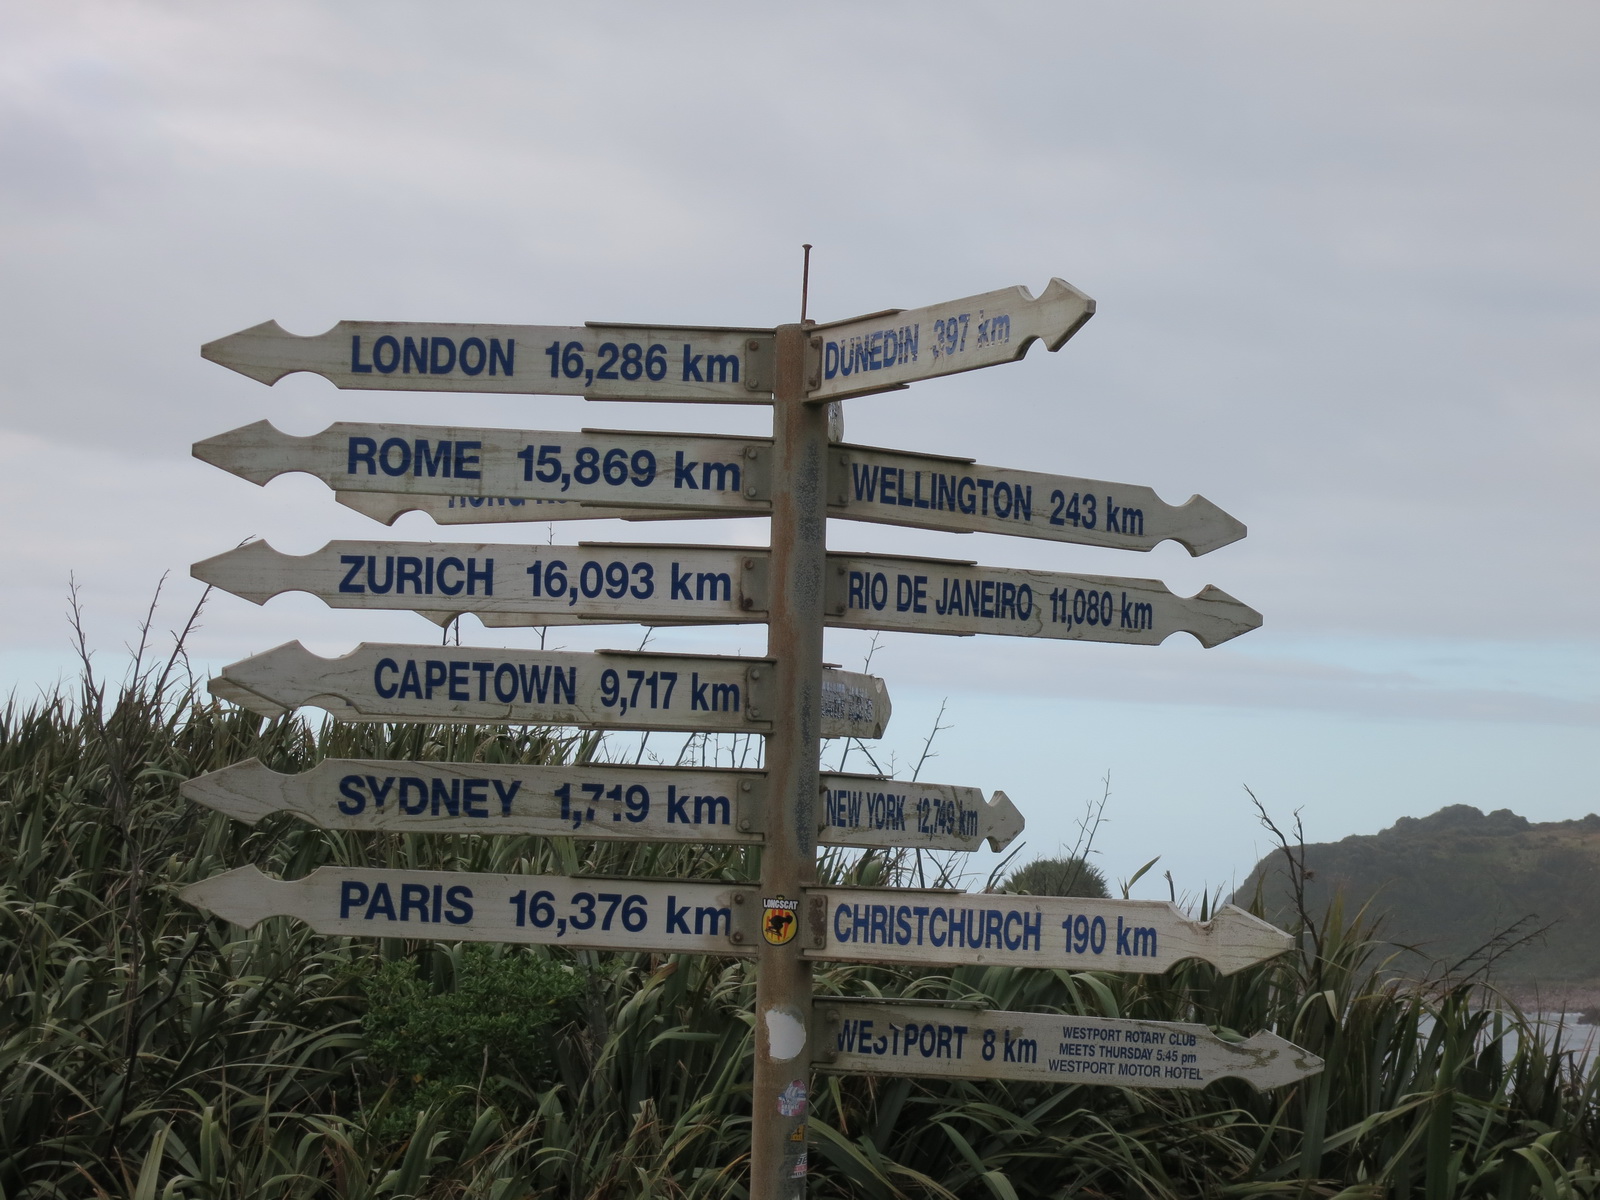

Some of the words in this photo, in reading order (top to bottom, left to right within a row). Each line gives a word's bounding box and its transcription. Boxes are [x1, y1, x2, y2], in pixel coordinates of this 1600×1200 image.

[352, 335, 515, 377] LONDON
[545, 340, 668, 387] 16,286
[682, 344, 740, 384] km
[824, 323, 919, 380] DUNEDIN
[931, 313, 970, 358] 397
[977, 309, 1011, 349] km
[347, 437, 482, 480] ROME
[517, 445, 657, 492] 15,869
[674, 451, 742, 491] km
[852, 463, 1033, 522] WELLINGTON
[1049, 490, 1098, 530] 243
[1106, 497, 1144, 536] km
[339, 555, 494, 596] ZURICH
[526, 560, 655, 606] 16,093
[671, 563, 731, 601] km
[848, 571, 888, 611] RIO
[896, 575, 928, 614] DE
[935, 578, 1033, 621] JANEIRO
[1049, 587, 1113, 632] 11,080
[1120, 592, 1153, 630] km
[374, 658, 577, 704] CAPETOWN
[600, 668, 678, 716] 9,717
[691, 672, 740, 711] km
[337, 775, 523, 818] SYDNEY
[553, 782, 651, 829] 1,719
[667, 785, 731, 825] km
[825, 789, 863, 828] NEW
[866, 791, 906, 832] YORK
[916, 797, 955, 842] 12,749
[957, 801, 978, 837] km
[339, 881, 474, 925] PARIS
[509, 889, 648, 937] 16,376
[665, 895, 732, 936] km
[833, 903, 1041, 951] CHRISTCHURCH
[1062, 914, 1106, 954] 190
[1116, 916, 1158, 957] km
[981, 1028, 996, 1061] 8
[1003, 1029, 1038, 1064] km
[1059, 1043, 1095, 1057] MEETS
[1099, 1046, 1153, 1060] THURSDAY
[1156, 1050, 1178, 1063] 5.45
[1181, 1053, 1197, 1065] pm
[1062, 1026, 1121, 1042] WESTPORT
[1125, 1031, 1166, 1044] ROTARY
[1168, 1033, 1197, 1047] CLUB
[1048, 1058, 1115, 1074] WESTPORT
[1118, 1064, 1161, 1077] MOTOR
[1164, 1066, 1204, 1081] HOTEL
